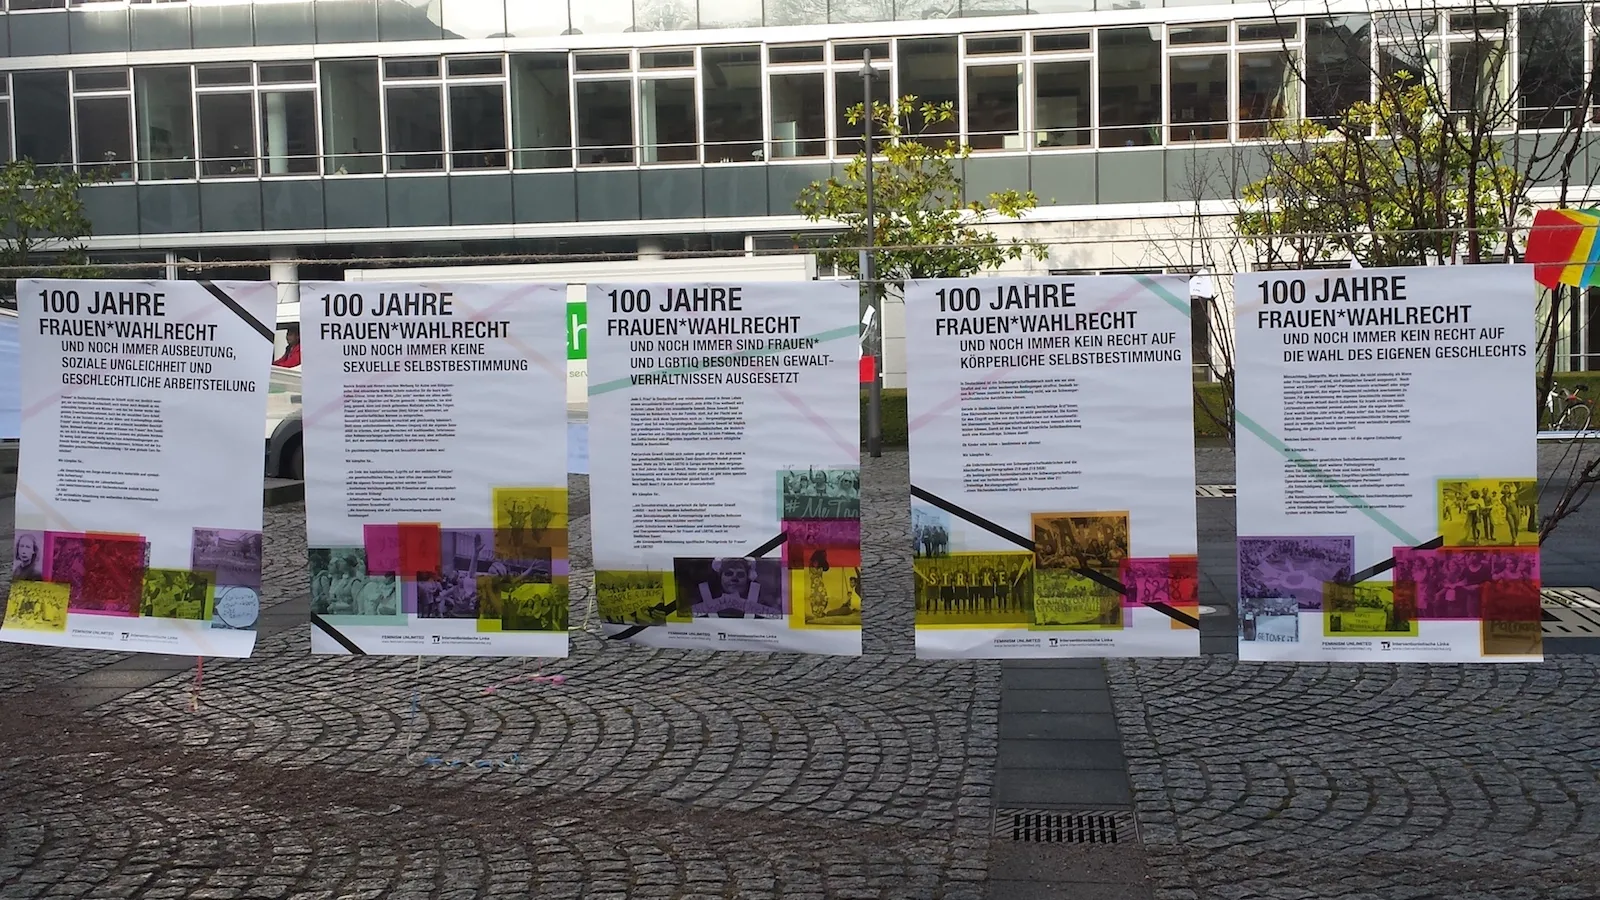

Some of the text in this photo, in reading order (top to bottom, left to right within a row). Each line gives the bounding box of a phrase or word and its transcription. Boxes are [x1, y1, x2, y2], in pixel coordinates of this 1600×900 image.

[936, 283, 1075, 311] 100 JAHRE
[1259, 276, 1406, 304] 100 JAHRE
[39, 290, 165, 316] 100 JAHRE
[321, 293, 452, 316] 100 JAHRE
[608, 288, 741, 312] 100 JAHRE
[961, 333, 1175, 351] UND NOCH IMMER KEIN RECHT AUF
[1284, 328, 1504, 344] UND NOCH IMMER KEIN RECHT AUF
[62, 341, 235, 360] UND NOCH IMMER AUSBEUTUNG,
[344, 344, 484, 355] UND NOCH IMMER KEINE
[631, 341, 653, 351] UND
[658, 340, 688, 351] NOCH
[694, 340, 732, 350] IMMER
[737, 339, 763, 350] SIND
[1284, 345, 1526, 361] DIE WAHL DES EIGENEN GESCHLECHTS
[62, 357, 211, 373] SOZIALE UNGLEICHHEIT UND
[344, 360, 527, 372] SEXUELLE SELBSTBESTIMMUNG
[631, 355, 833, 368] UND LGBTIQ BESONDEREN GEWALT-
[961, 350, 1180, 368] KÖRPERLICHE SELBSTBESTIMMUNG
[63, 373, 255, 392] GESCHLECHTLICHE ARBEITSTEILUNG
[631, 372, 799, 385] VERHÄLTNISSEN AUSGESETZT
[929, 571, 1006, 585] STRIKE
